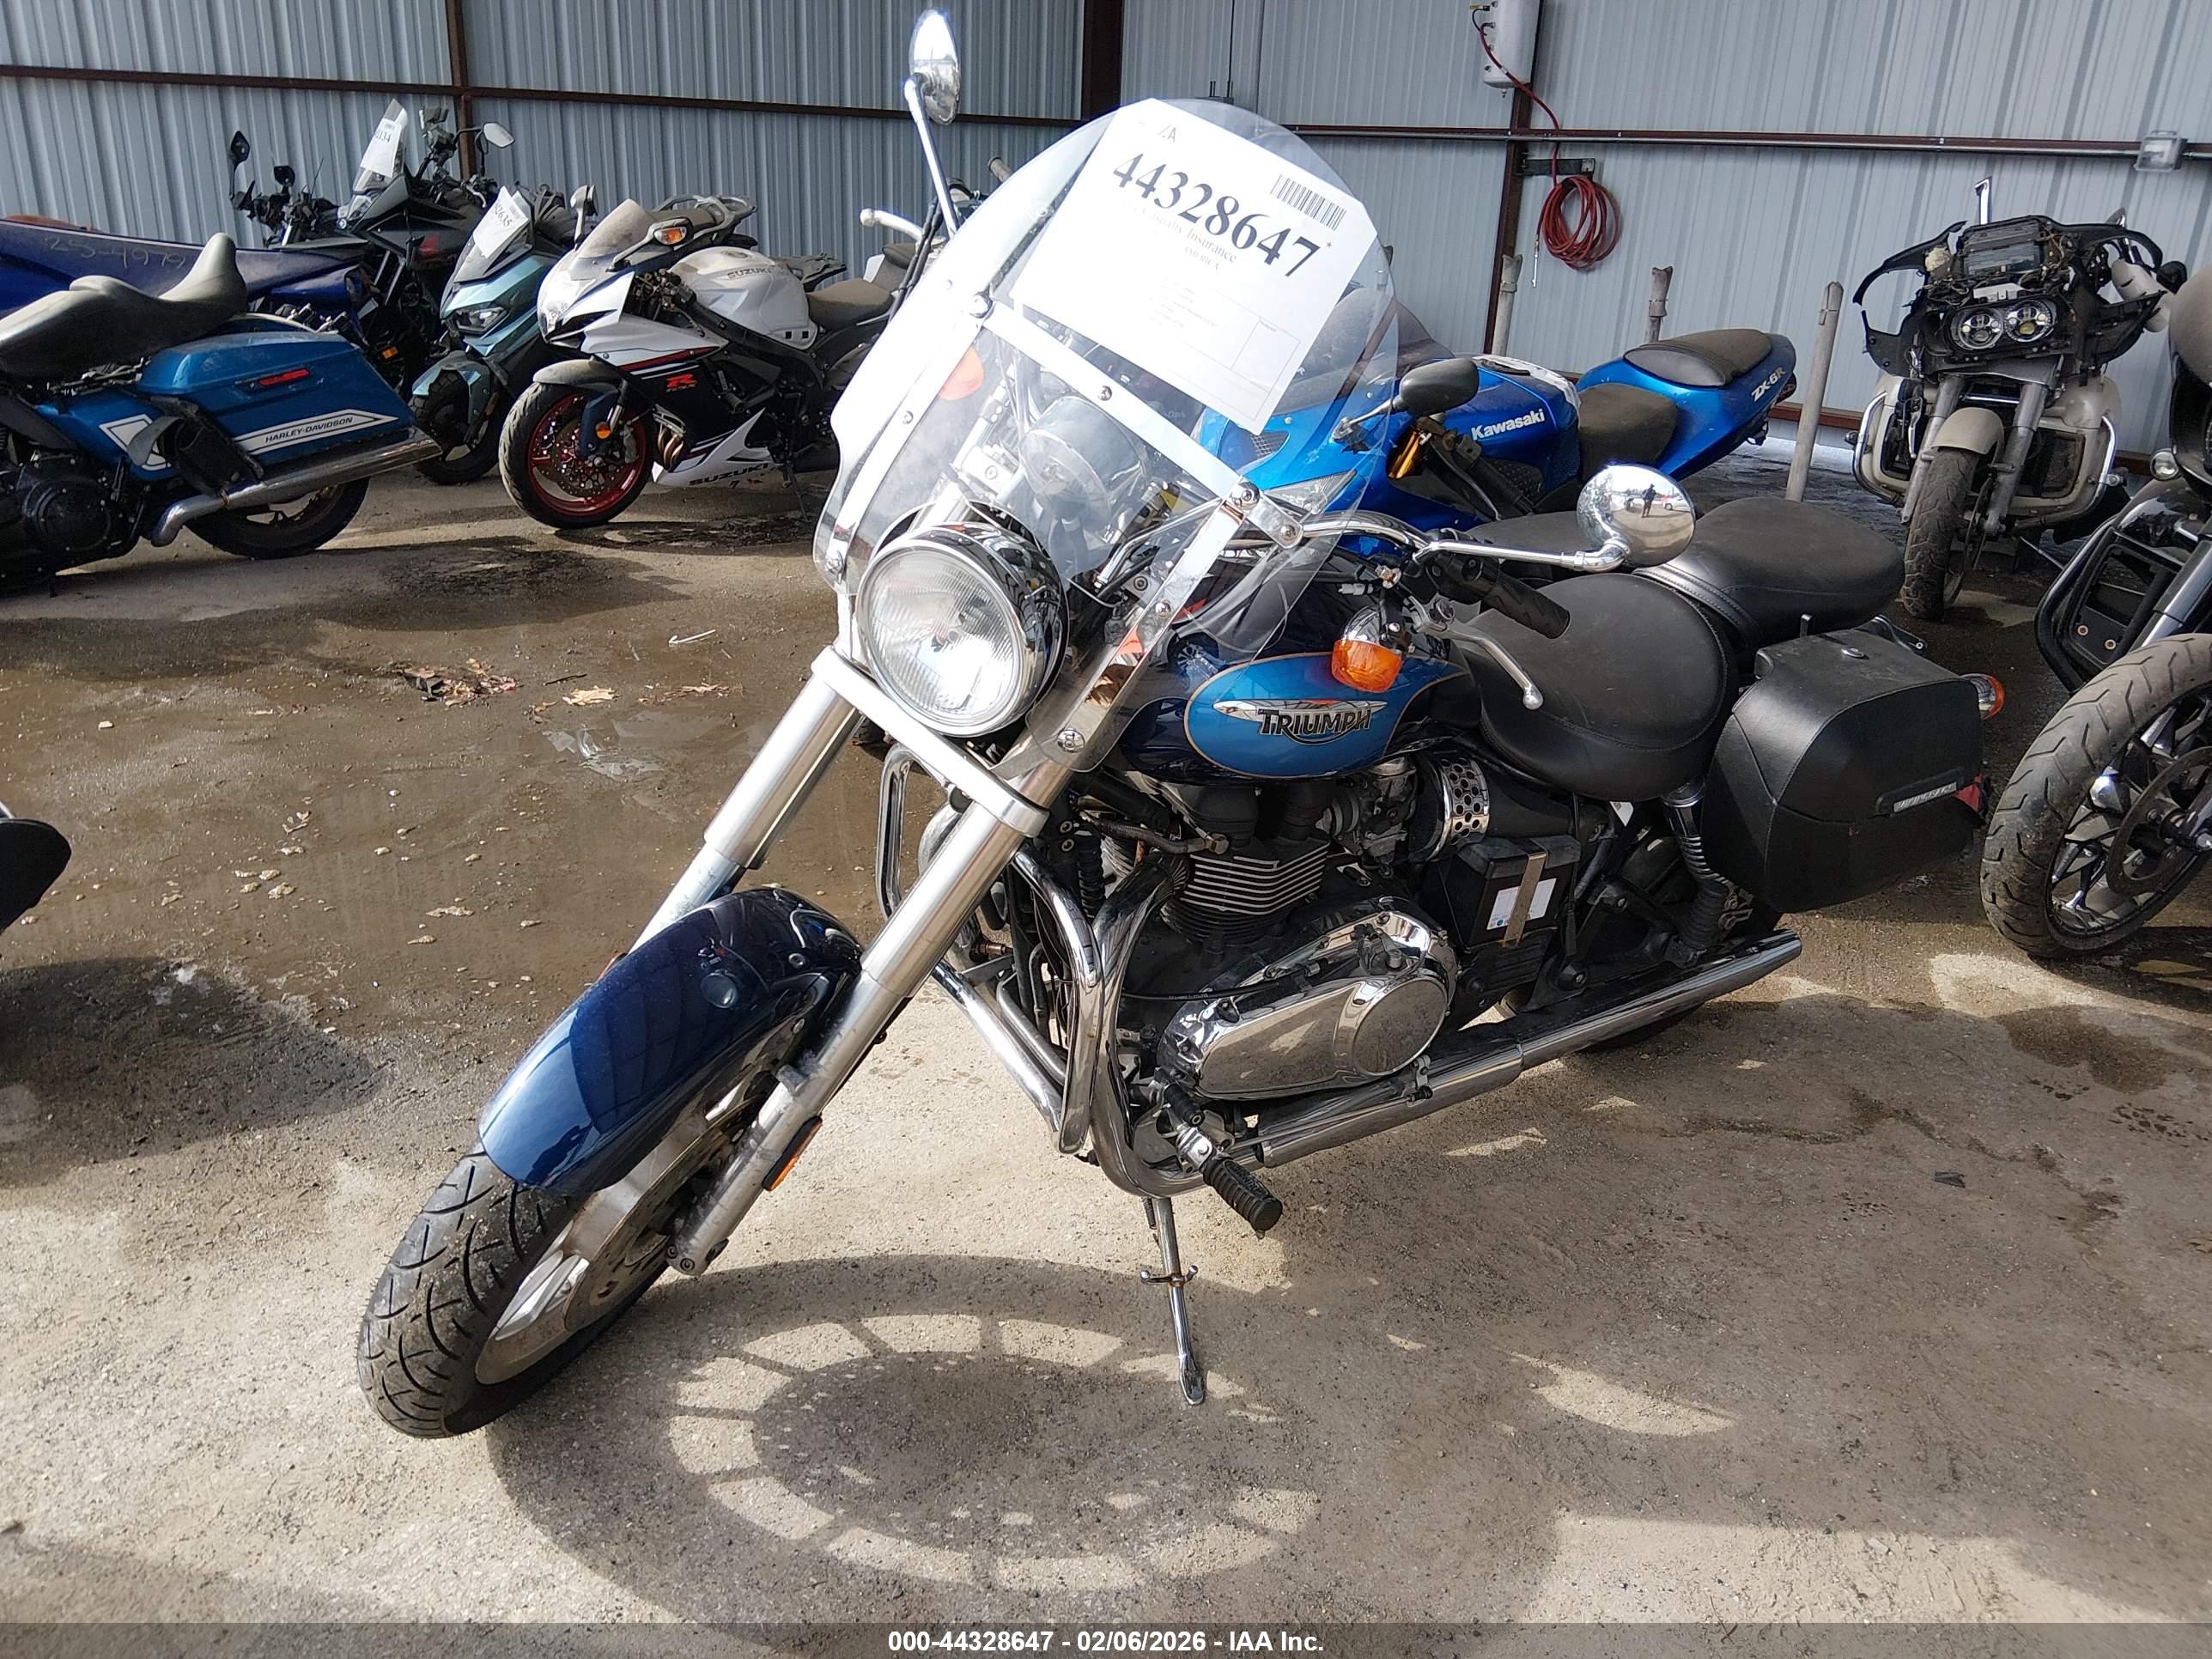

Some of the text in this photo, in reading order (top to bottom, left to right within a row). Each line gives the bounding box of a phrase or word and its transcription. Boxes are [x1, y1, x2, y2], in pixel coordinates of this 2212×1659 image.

[1112, 153, 1321, 277] 44328647
[1751, 367, 1786, 402] ZX-6R
[265, 416, 353, 443] HARLEY-DAVIDSON
[1471, 409, 1546, 441] Kawasaki
[690, 463, 769, 485] SUZUKI
[1257, 708, 1372, 744] TRIUMPH
